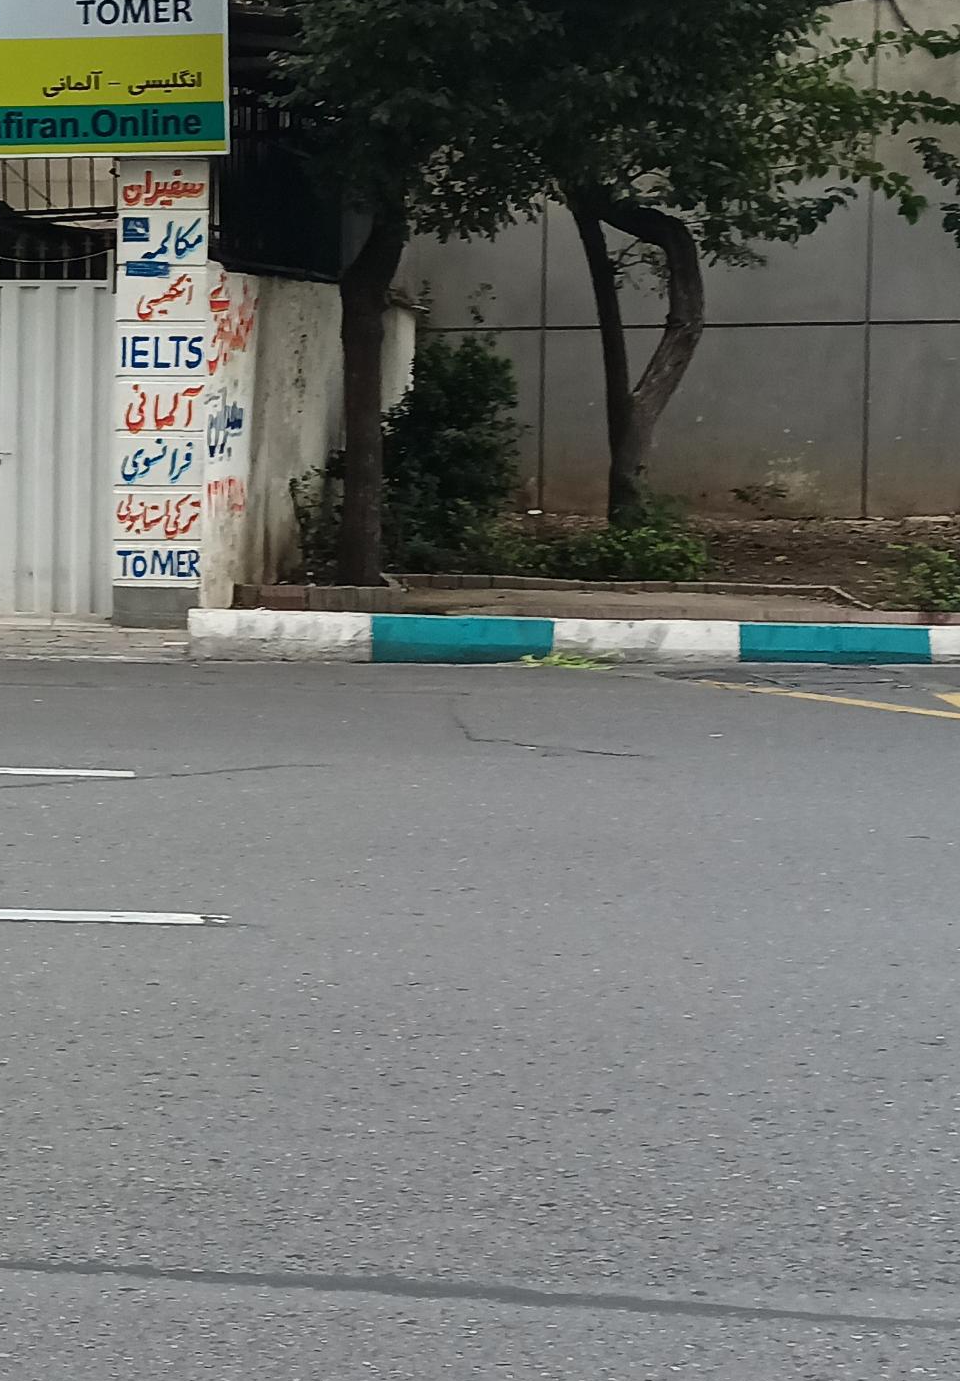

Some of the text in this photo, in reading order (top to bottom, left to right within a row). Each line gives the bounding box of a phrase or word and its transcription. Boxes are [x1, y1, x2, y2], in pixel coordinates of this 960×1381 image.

[42, 71, 103, 99] آلمانی
[127, 70, 202, 97] انگلیسی
[122, 169, 205, 206] سفیران
[141, 218, 204, 259] مکالمه
[121, 335, 204, 369] IELTS
[125, 384, 205, 434] آلمانی
[120, 438, 194, 484] فرانسوی
